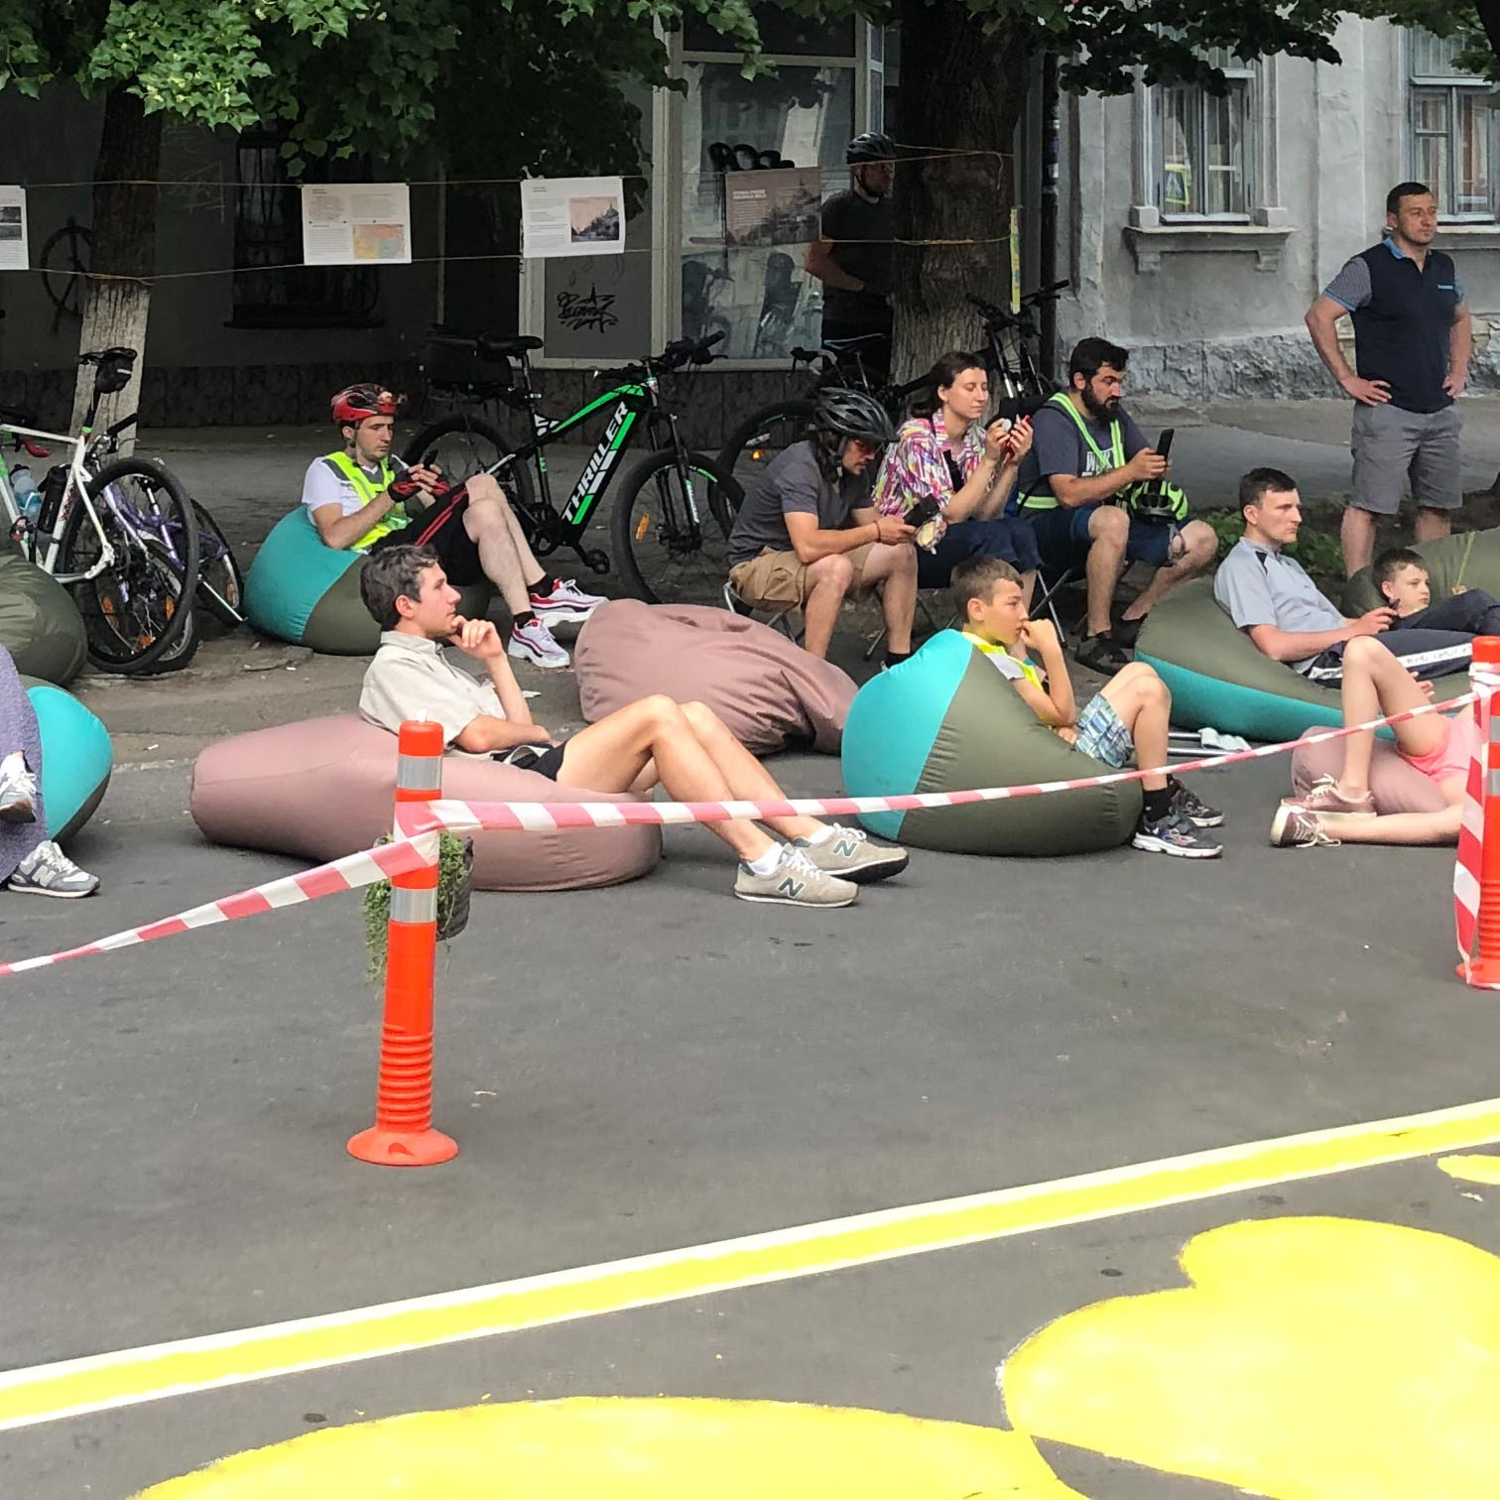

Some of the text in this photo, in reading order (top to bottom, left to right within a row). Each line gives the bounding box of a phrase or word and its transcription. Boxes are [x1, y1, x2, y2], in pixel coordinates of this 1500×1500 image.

[561, 401, 628, 522] THRILLER
[832, 839, 859, 857] N
[31, 865, 57, 888] N
[778, 877, 806, 899] N
